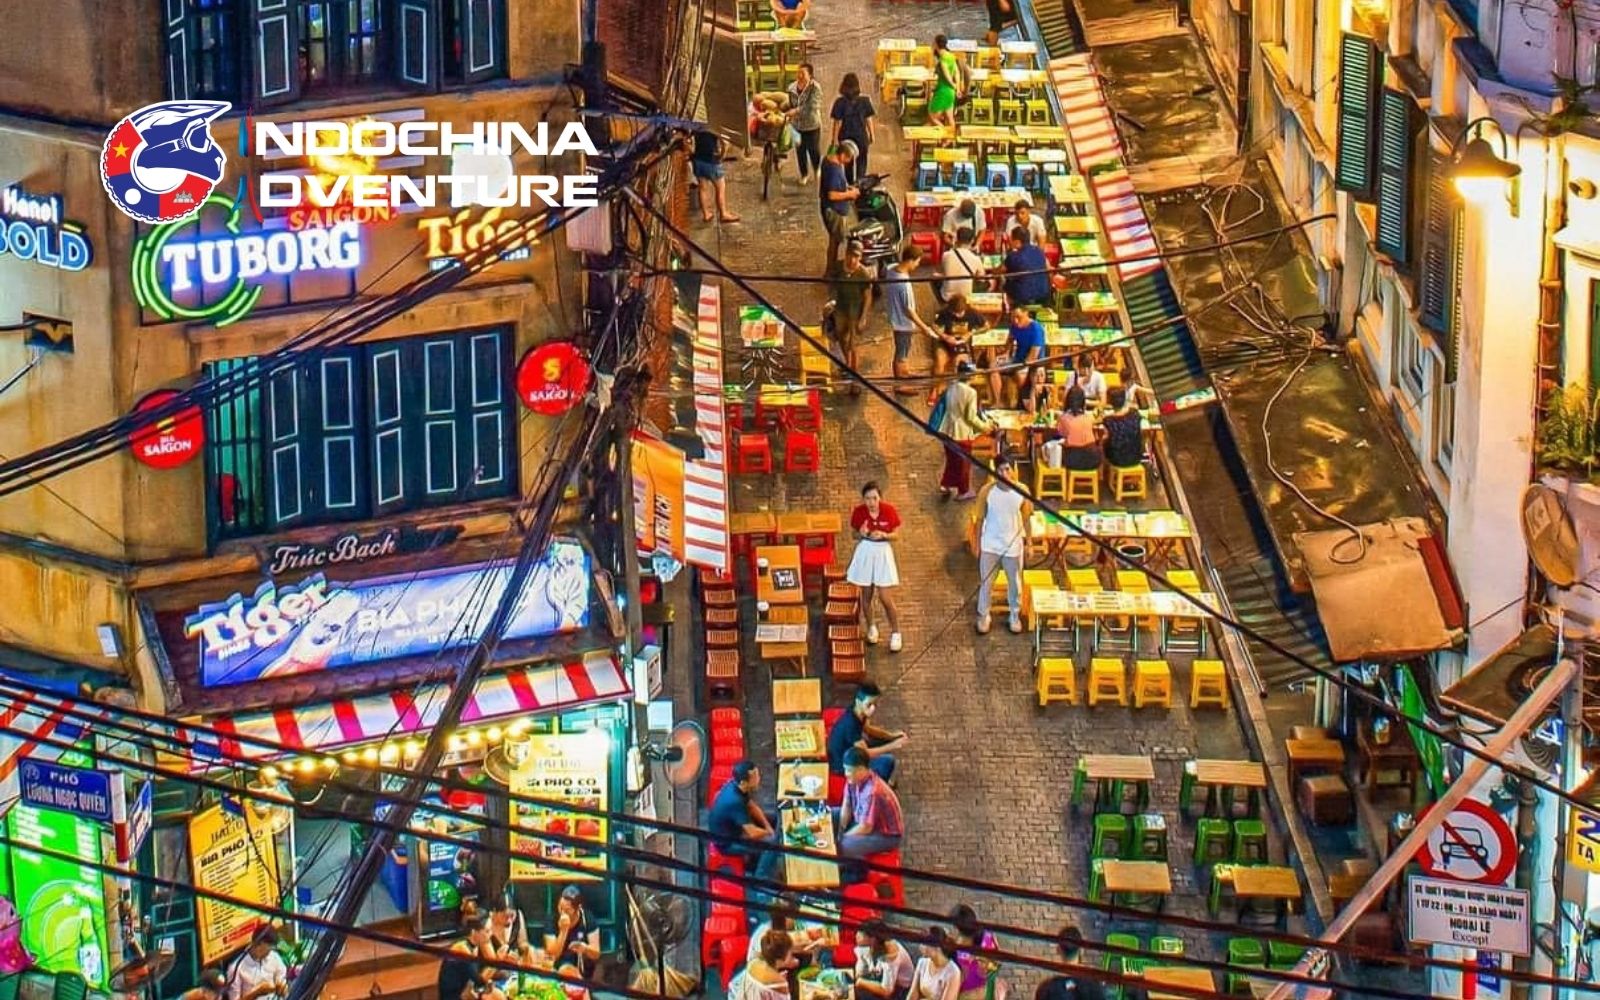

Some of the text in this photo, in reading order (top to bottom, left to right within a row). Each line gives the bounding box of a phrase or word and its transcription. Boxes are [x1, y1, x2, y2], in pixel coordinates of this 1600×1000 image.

[163, 222, 360, 291] TUBORG
[144, 440, 192, 456] SAIGON
[270, 546, 326, 574] Trúc
[1452, 930, 1489, 946] Except
